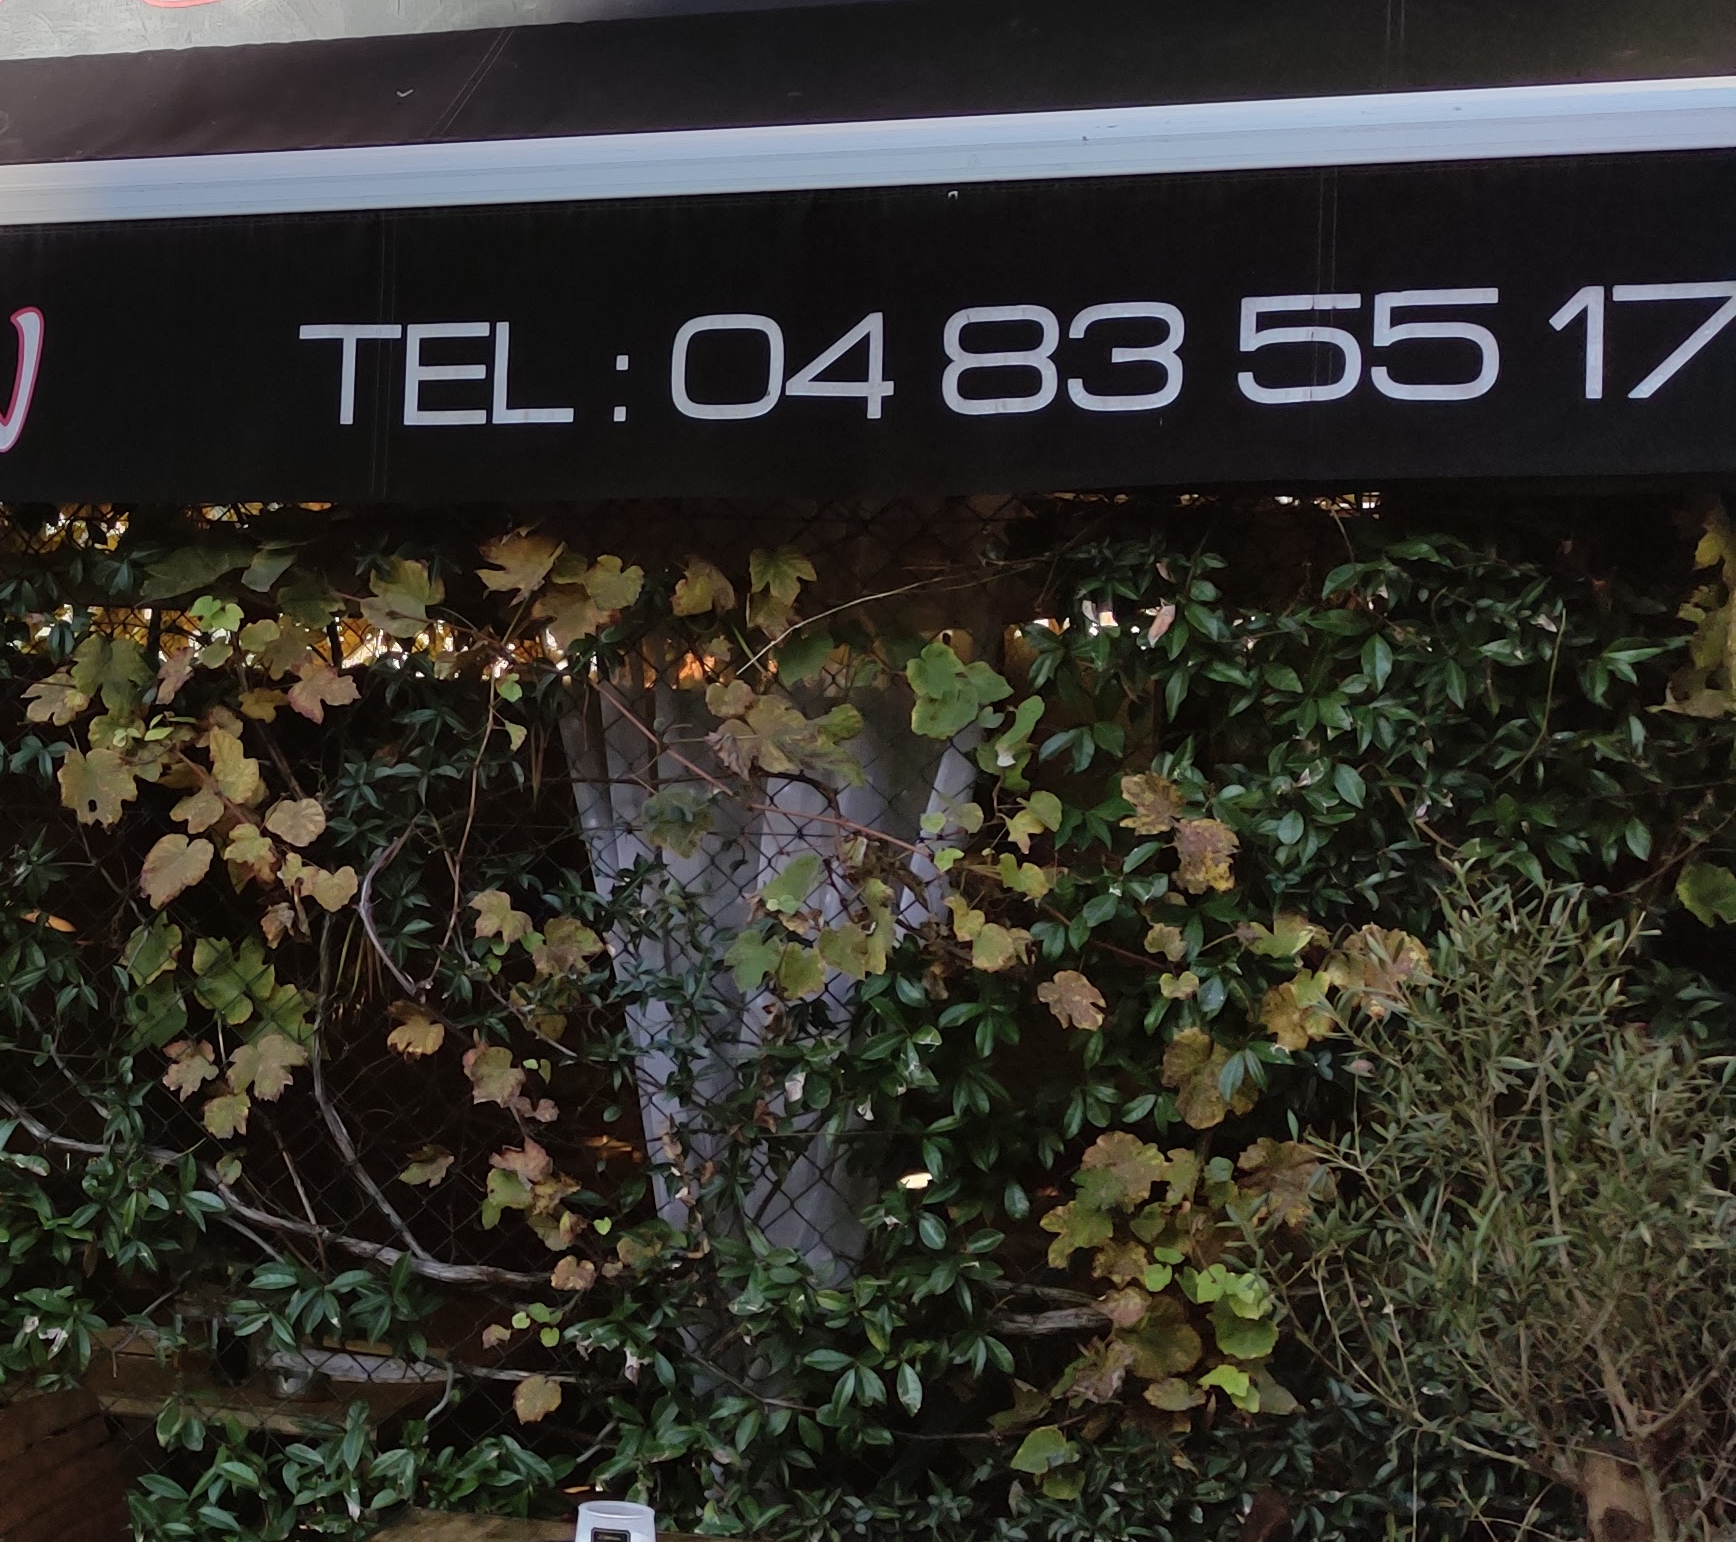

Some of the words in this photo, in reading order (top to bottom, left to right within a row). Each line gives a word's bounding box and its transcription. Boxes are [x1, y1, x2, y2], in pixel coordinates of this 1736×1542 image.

[299, 321, 574, 426] TEL
[671, 312, 895, 420] 04
[942, 301, 1185, 416] 83
[1237, 287, 1500, 404] 55
[1548, 280, 1736, 399] 17
